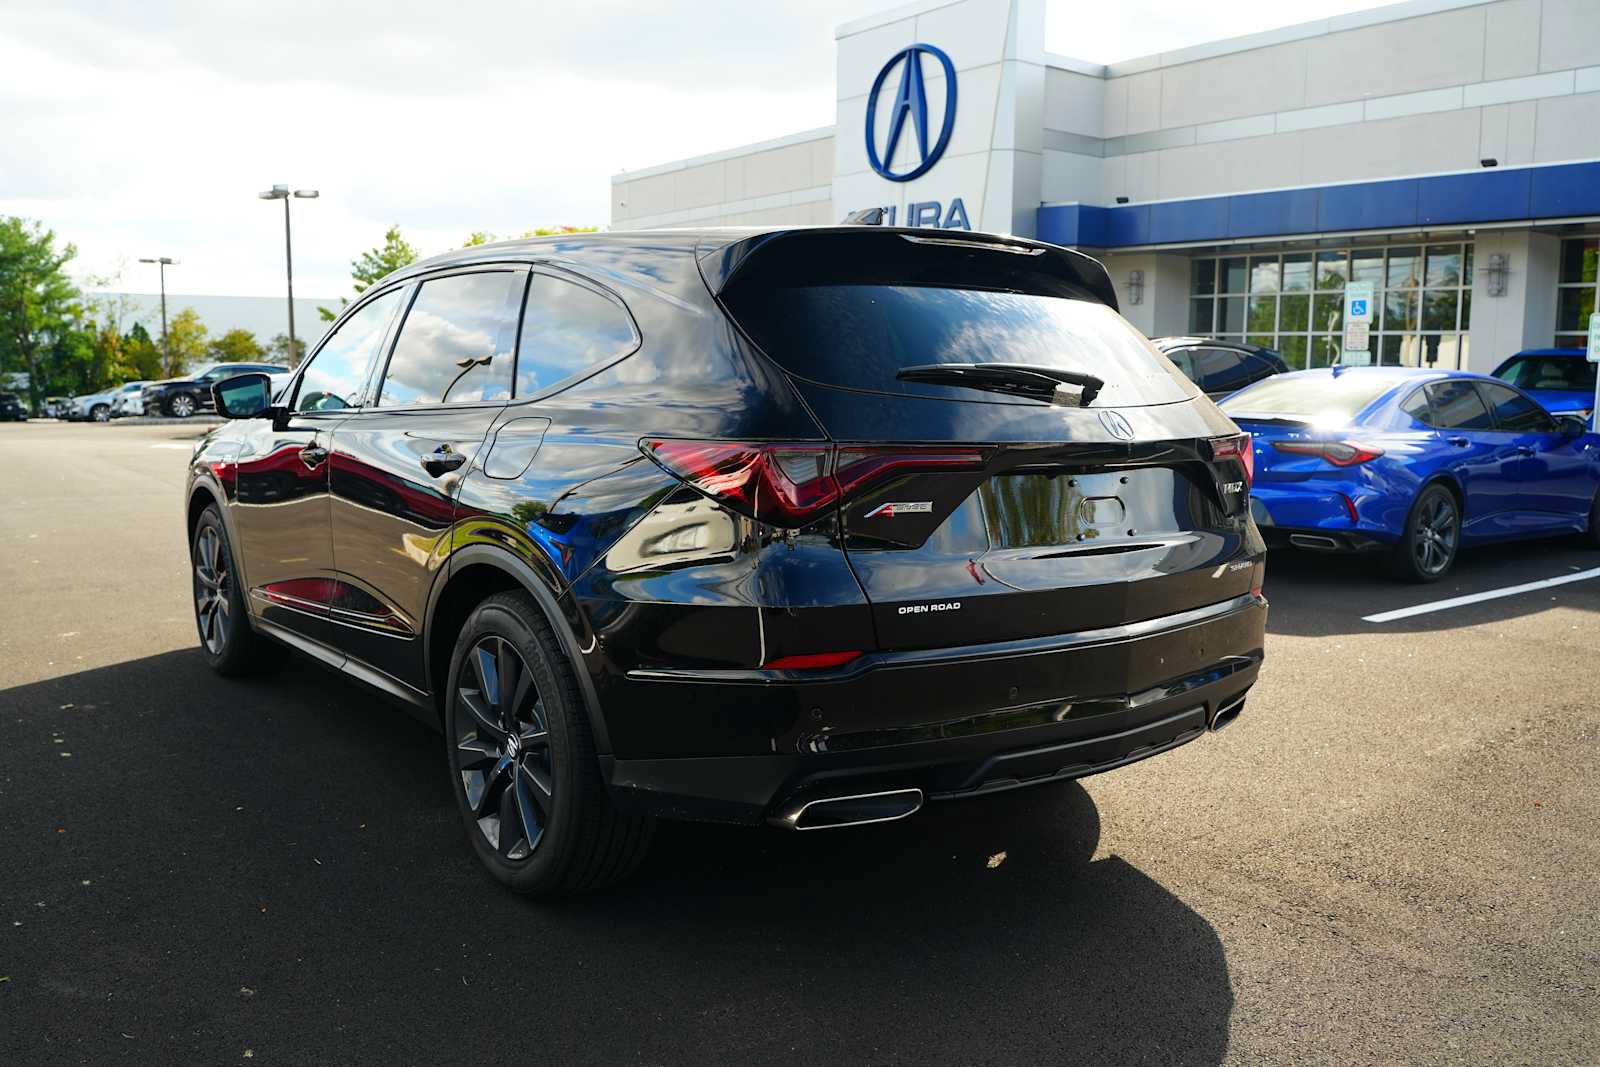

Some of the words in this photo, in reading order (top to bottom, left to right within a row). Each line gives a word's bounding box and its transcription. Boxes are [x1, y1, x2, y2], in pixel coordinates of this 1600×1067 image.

[881, 198, 971, 230] URA
[898, 605, 929, 614] OPEN
[930, 602, 961, 612] ROAD
